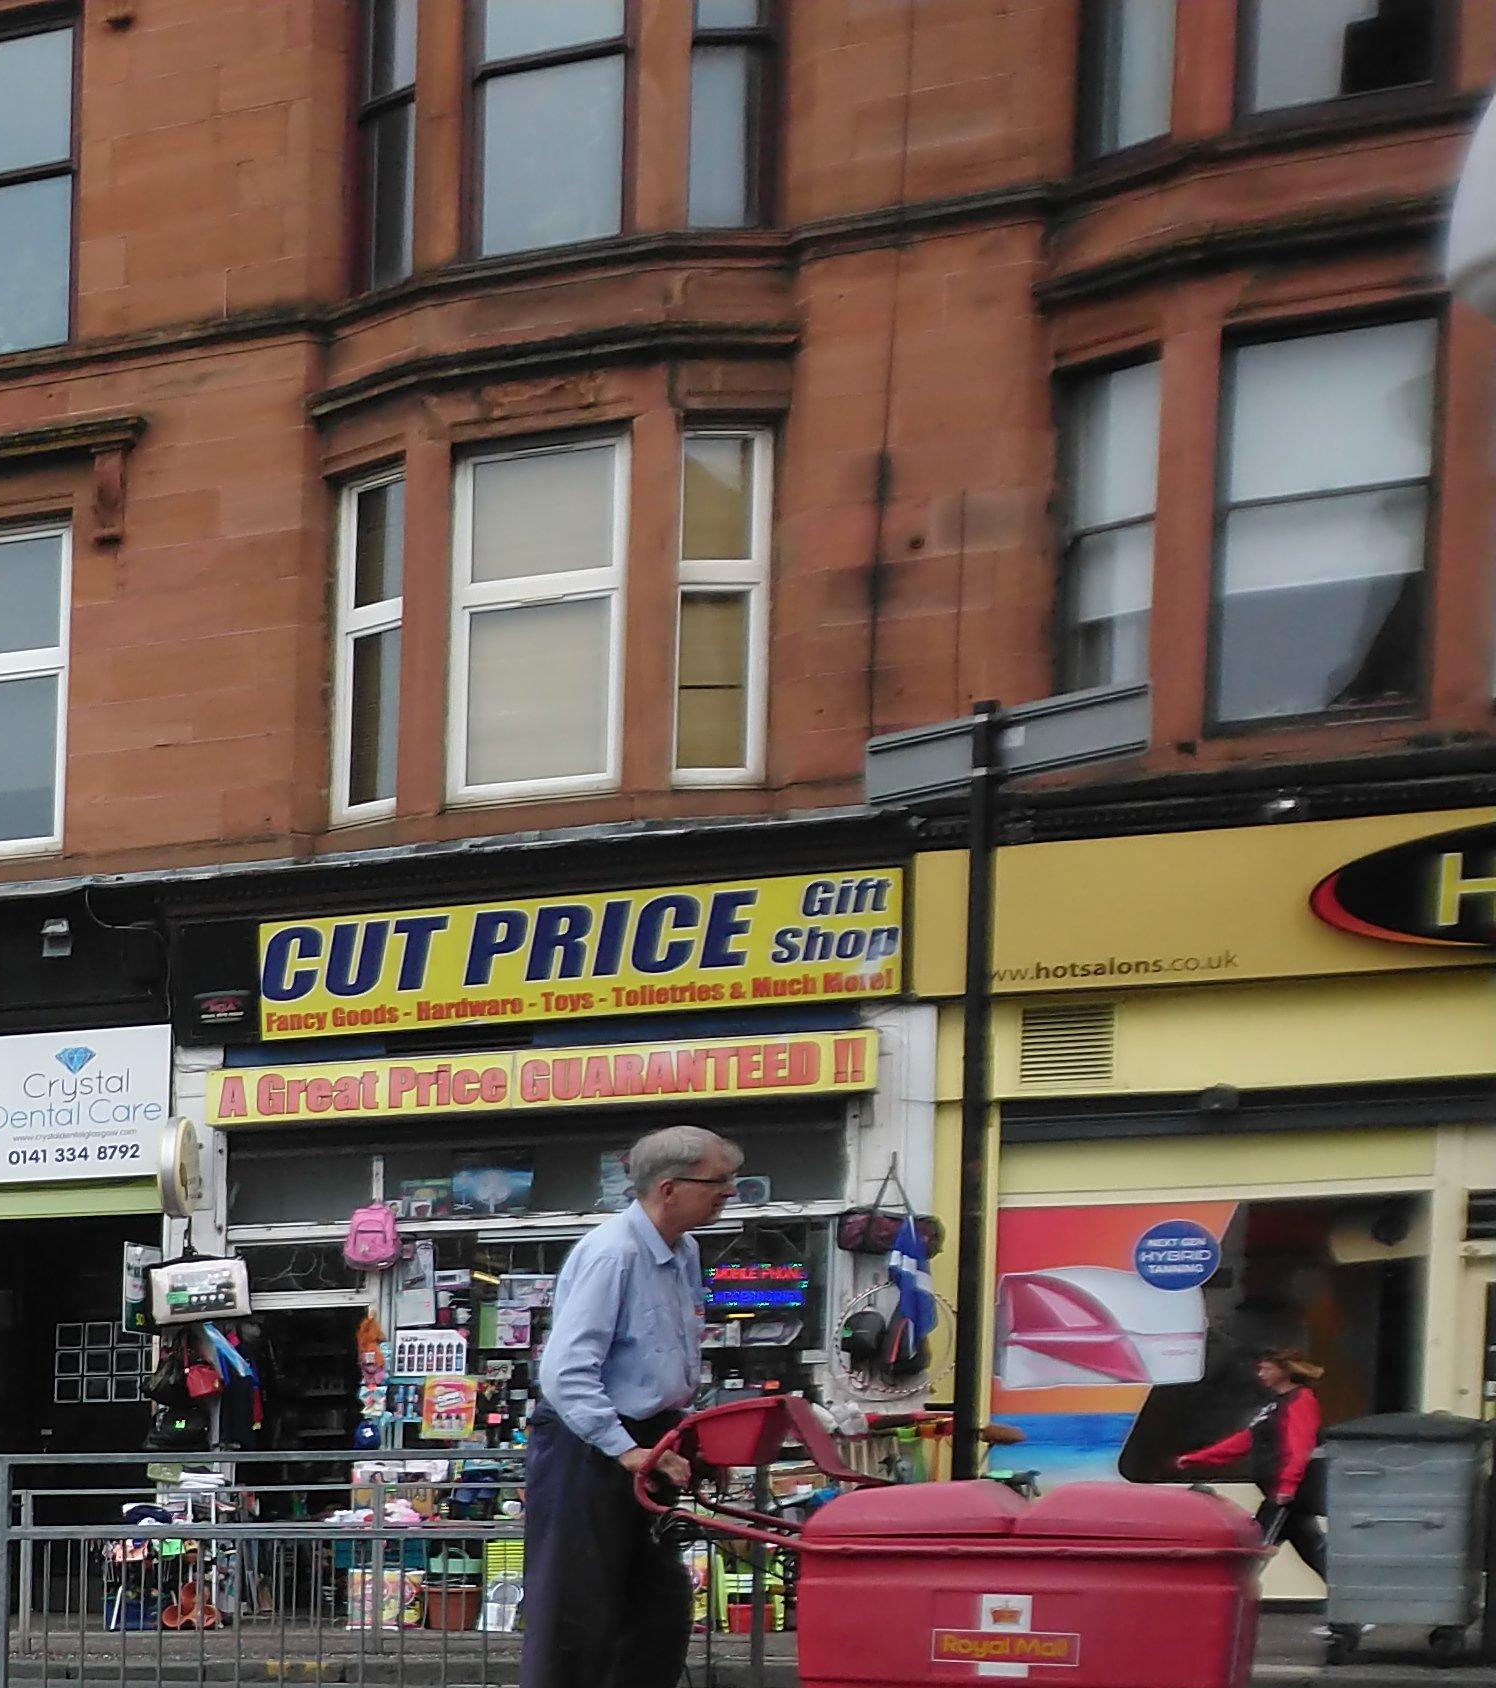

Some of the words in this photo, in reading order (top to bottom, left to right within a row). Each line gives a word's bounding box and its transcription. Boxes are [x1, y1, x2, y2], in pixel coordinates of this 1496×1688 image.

[802, 877, 890, 920] Gift
[260, 915, 450, 1001] CUT
[464, 892, 758, 986] PRICE
[771, 923, 899, 964] Shop
[991, 950, 1239, 981] ww.hotsalons.co.uk
[266, 1010, 327, 1032] Fancy
[332, 1004, 399, 1027] Goods
[416, 996, 524, 1021] Hardware
[540, 990, 594, 1013] Toys
[751, 974, 816, 999] Much
[23, 1068, 130, 1102] Crystal
[218, 1076, 248, 1118] A
[257, 1070, 377, 1115] Great
[388, 1062, 508, 1107] Price
[519, 1042, 814, 1102] GUARANTEED
[89, 1099, 162, 1124] Care
[8, 1149, 47, 1165] 0141
[54, 1146, 89, 1162] 334
[97, 1143, 140, 1160] 8792
[1141, 1250, 1211, 1262] HYBRID
[942, 1633, 1010, 1658] Royal
[1017, 1637, 1069, 1657] Mail
